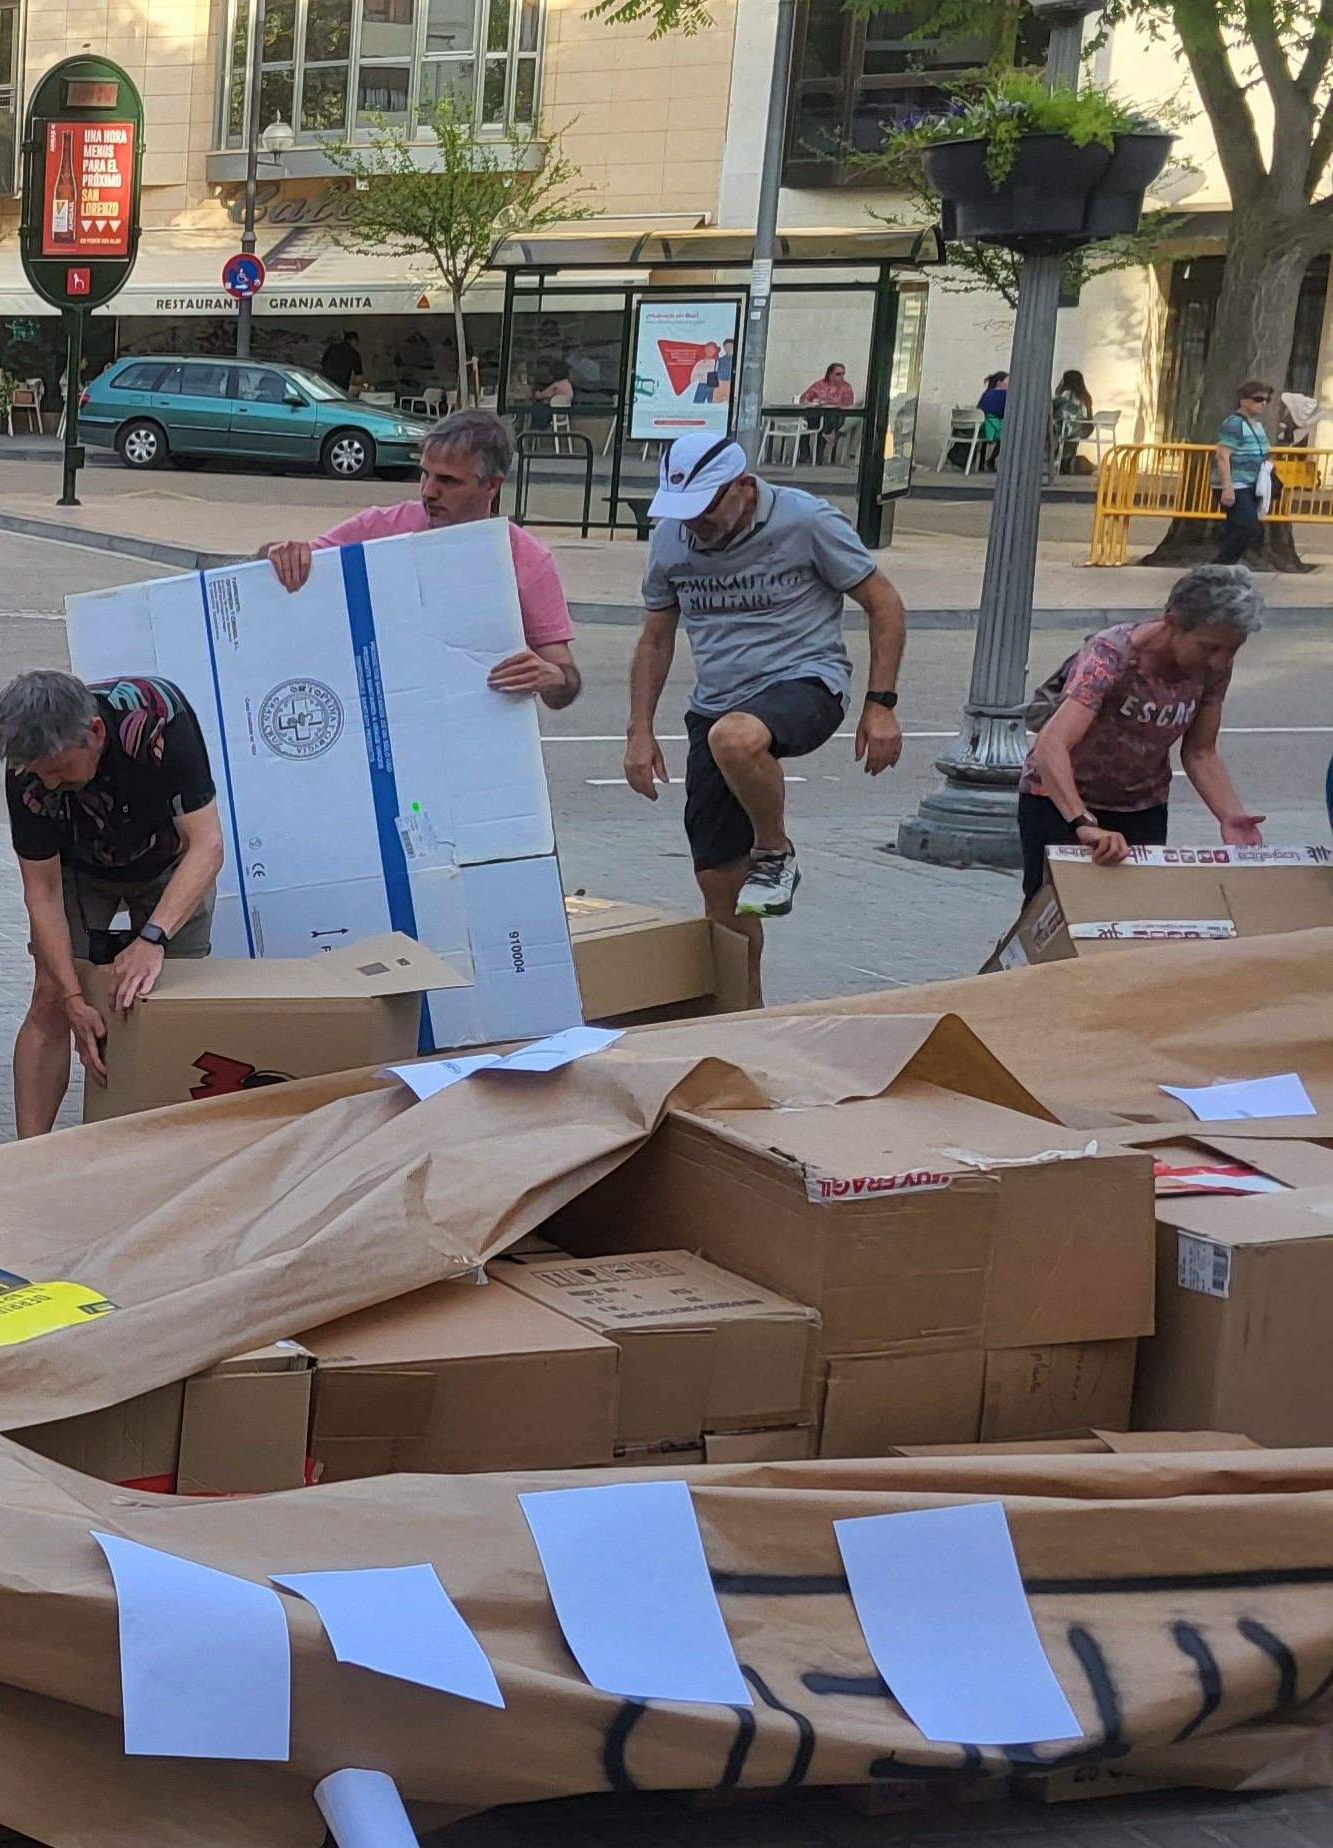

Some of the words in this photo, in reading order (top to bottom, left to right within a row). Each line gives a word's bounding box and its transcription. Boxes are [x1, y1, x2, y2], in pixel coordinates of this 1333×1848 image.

[84, 129, 101, 143] UNA
[103, 129, 127, 144] HORA
[83, 145, 114, 158] MENOS
[83, 160, 106, 172] PARA
[108, 160, 118, 172] EL
[82, 173, 122, 188] PRÓXIMO
[82, 188, 99, 202] SAN
[80, 201, 119, 217] LORENZO
[269, 297, 324, 312] GRANJA
[328, 296, 372, 310] ANITA
[509, 930, 526, 974] 910004
